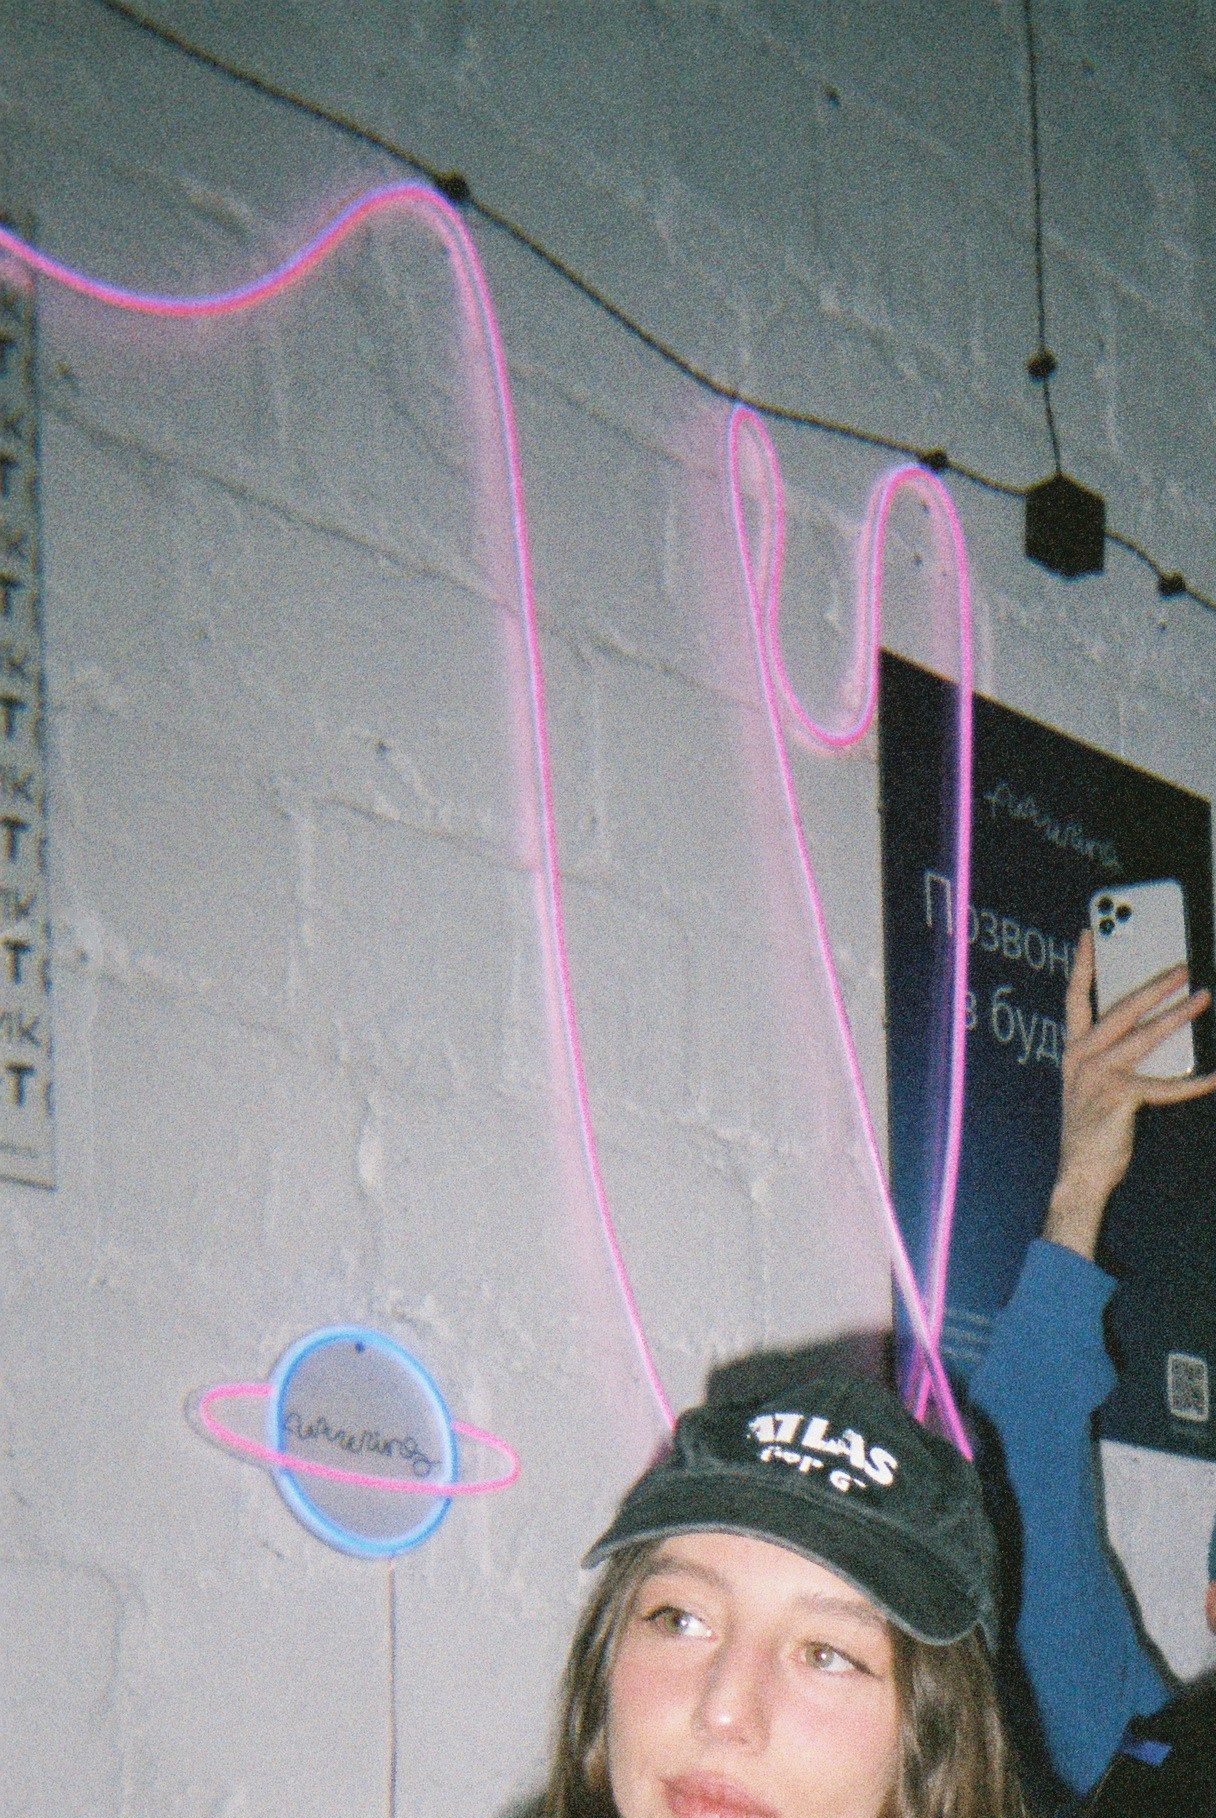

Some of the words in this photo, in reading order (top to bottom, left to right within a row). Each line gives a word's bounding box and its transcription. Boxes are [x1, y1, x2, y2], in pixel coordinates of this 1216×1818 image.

[924, 870, 1074, 980] Позвон
[991, 983, 1066, 1066] буд
[746, 1412, 898, 1487] ATLAS
